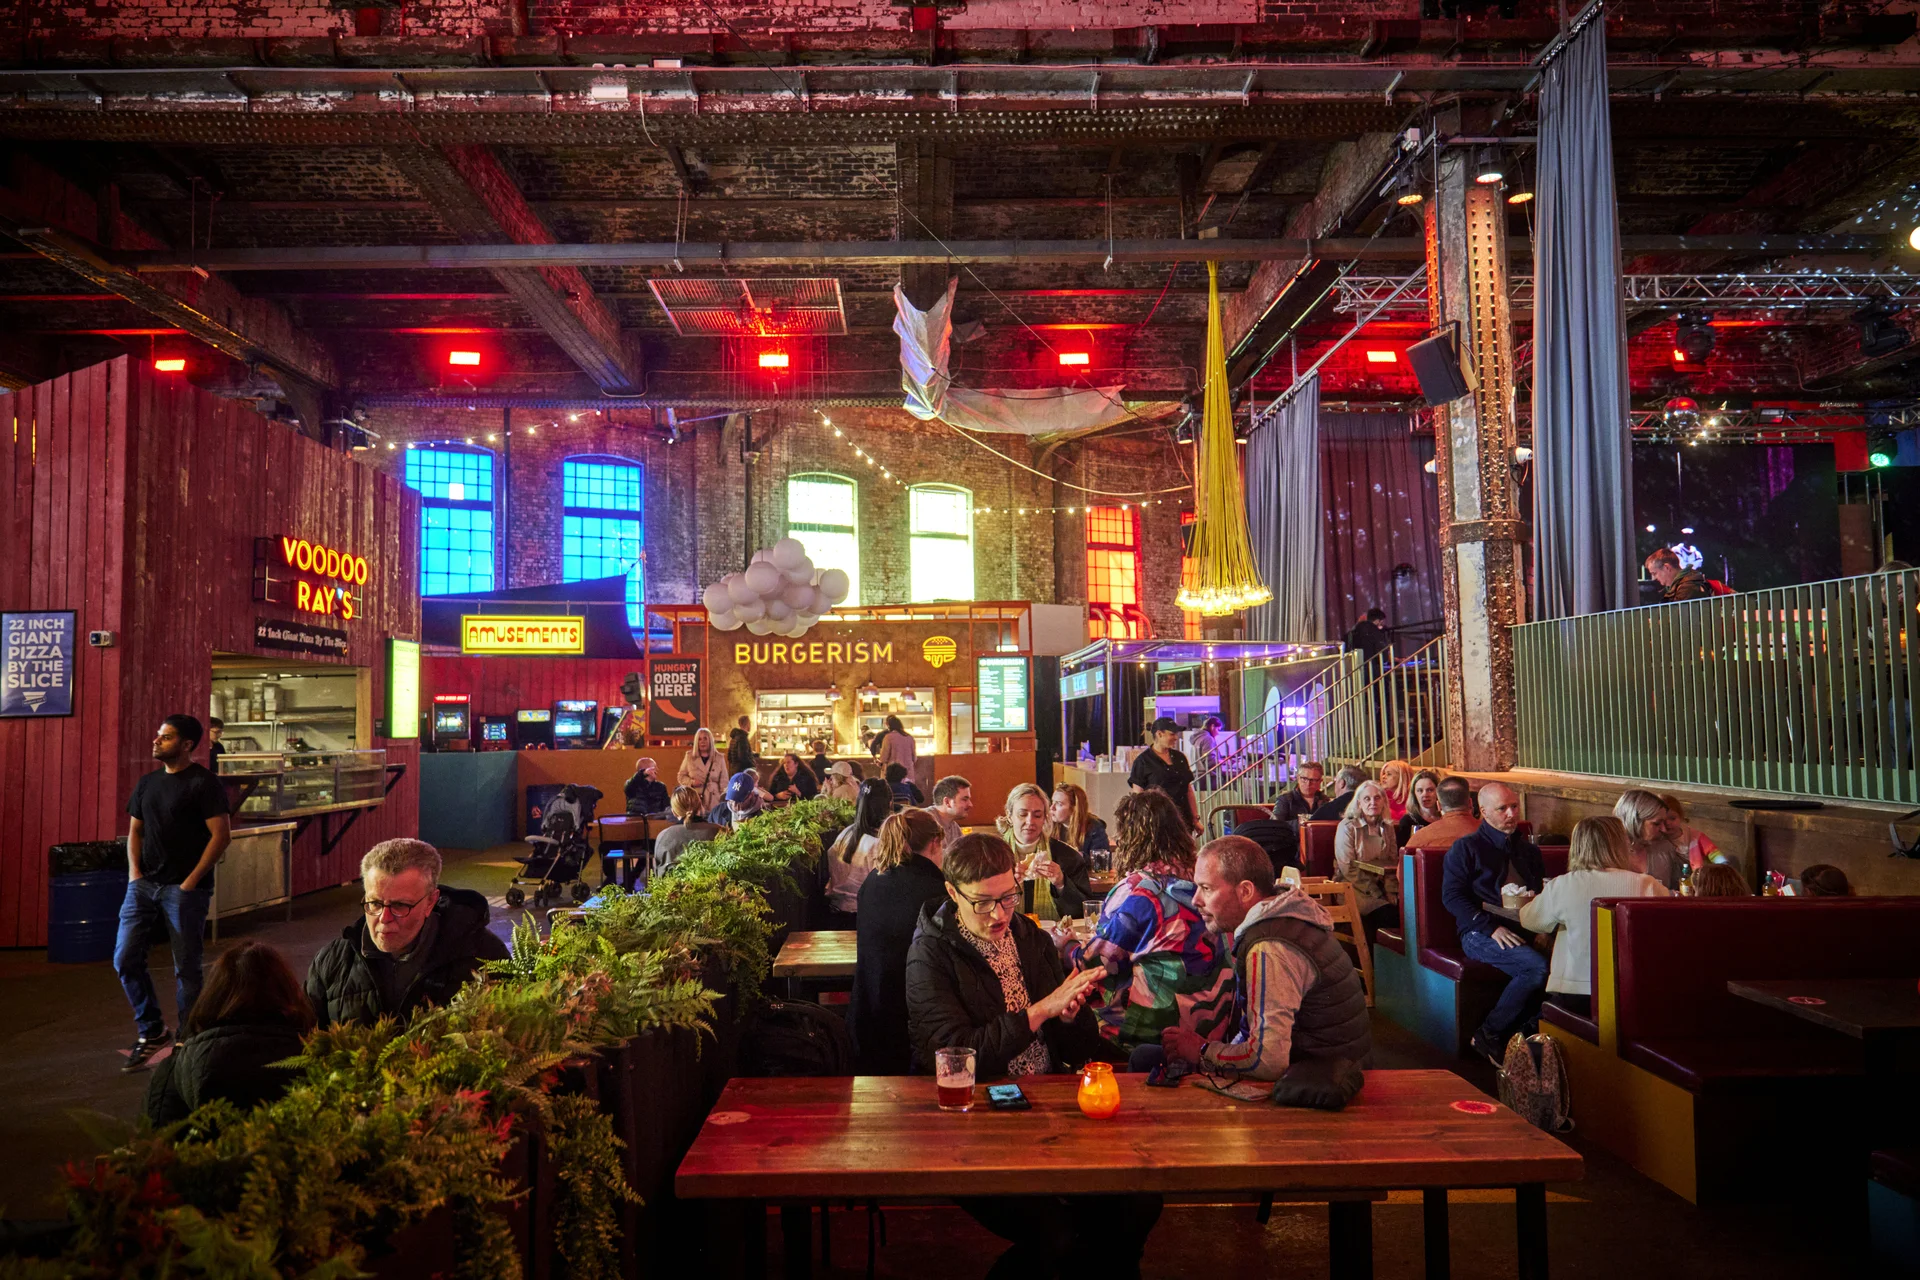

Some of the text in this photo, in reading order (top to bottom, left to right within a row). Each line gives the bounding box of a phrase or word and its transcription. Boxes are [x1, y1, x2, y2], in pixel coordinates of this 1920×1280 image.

[283, 537, 368, 585] VOODOO
[298, 581, 353, 619] RAY'S
[9, 618, 65, 630] 22 INCH
[8, 631, 64, 645] GIANT
[469, 626, 578, 643] AMUSEMENTS
[8, 645, 64, 659] PIZZA
[735, 642, 893, 664] BURGERISM
[8, 660, 64, 672] BY THE
[654, 663, 697, 672] HUNGRY?
[8, 673, 64, 688] SLICE
[654, 672, 696, 684] ORDER
[654, 684, 697, 697] HERE.
